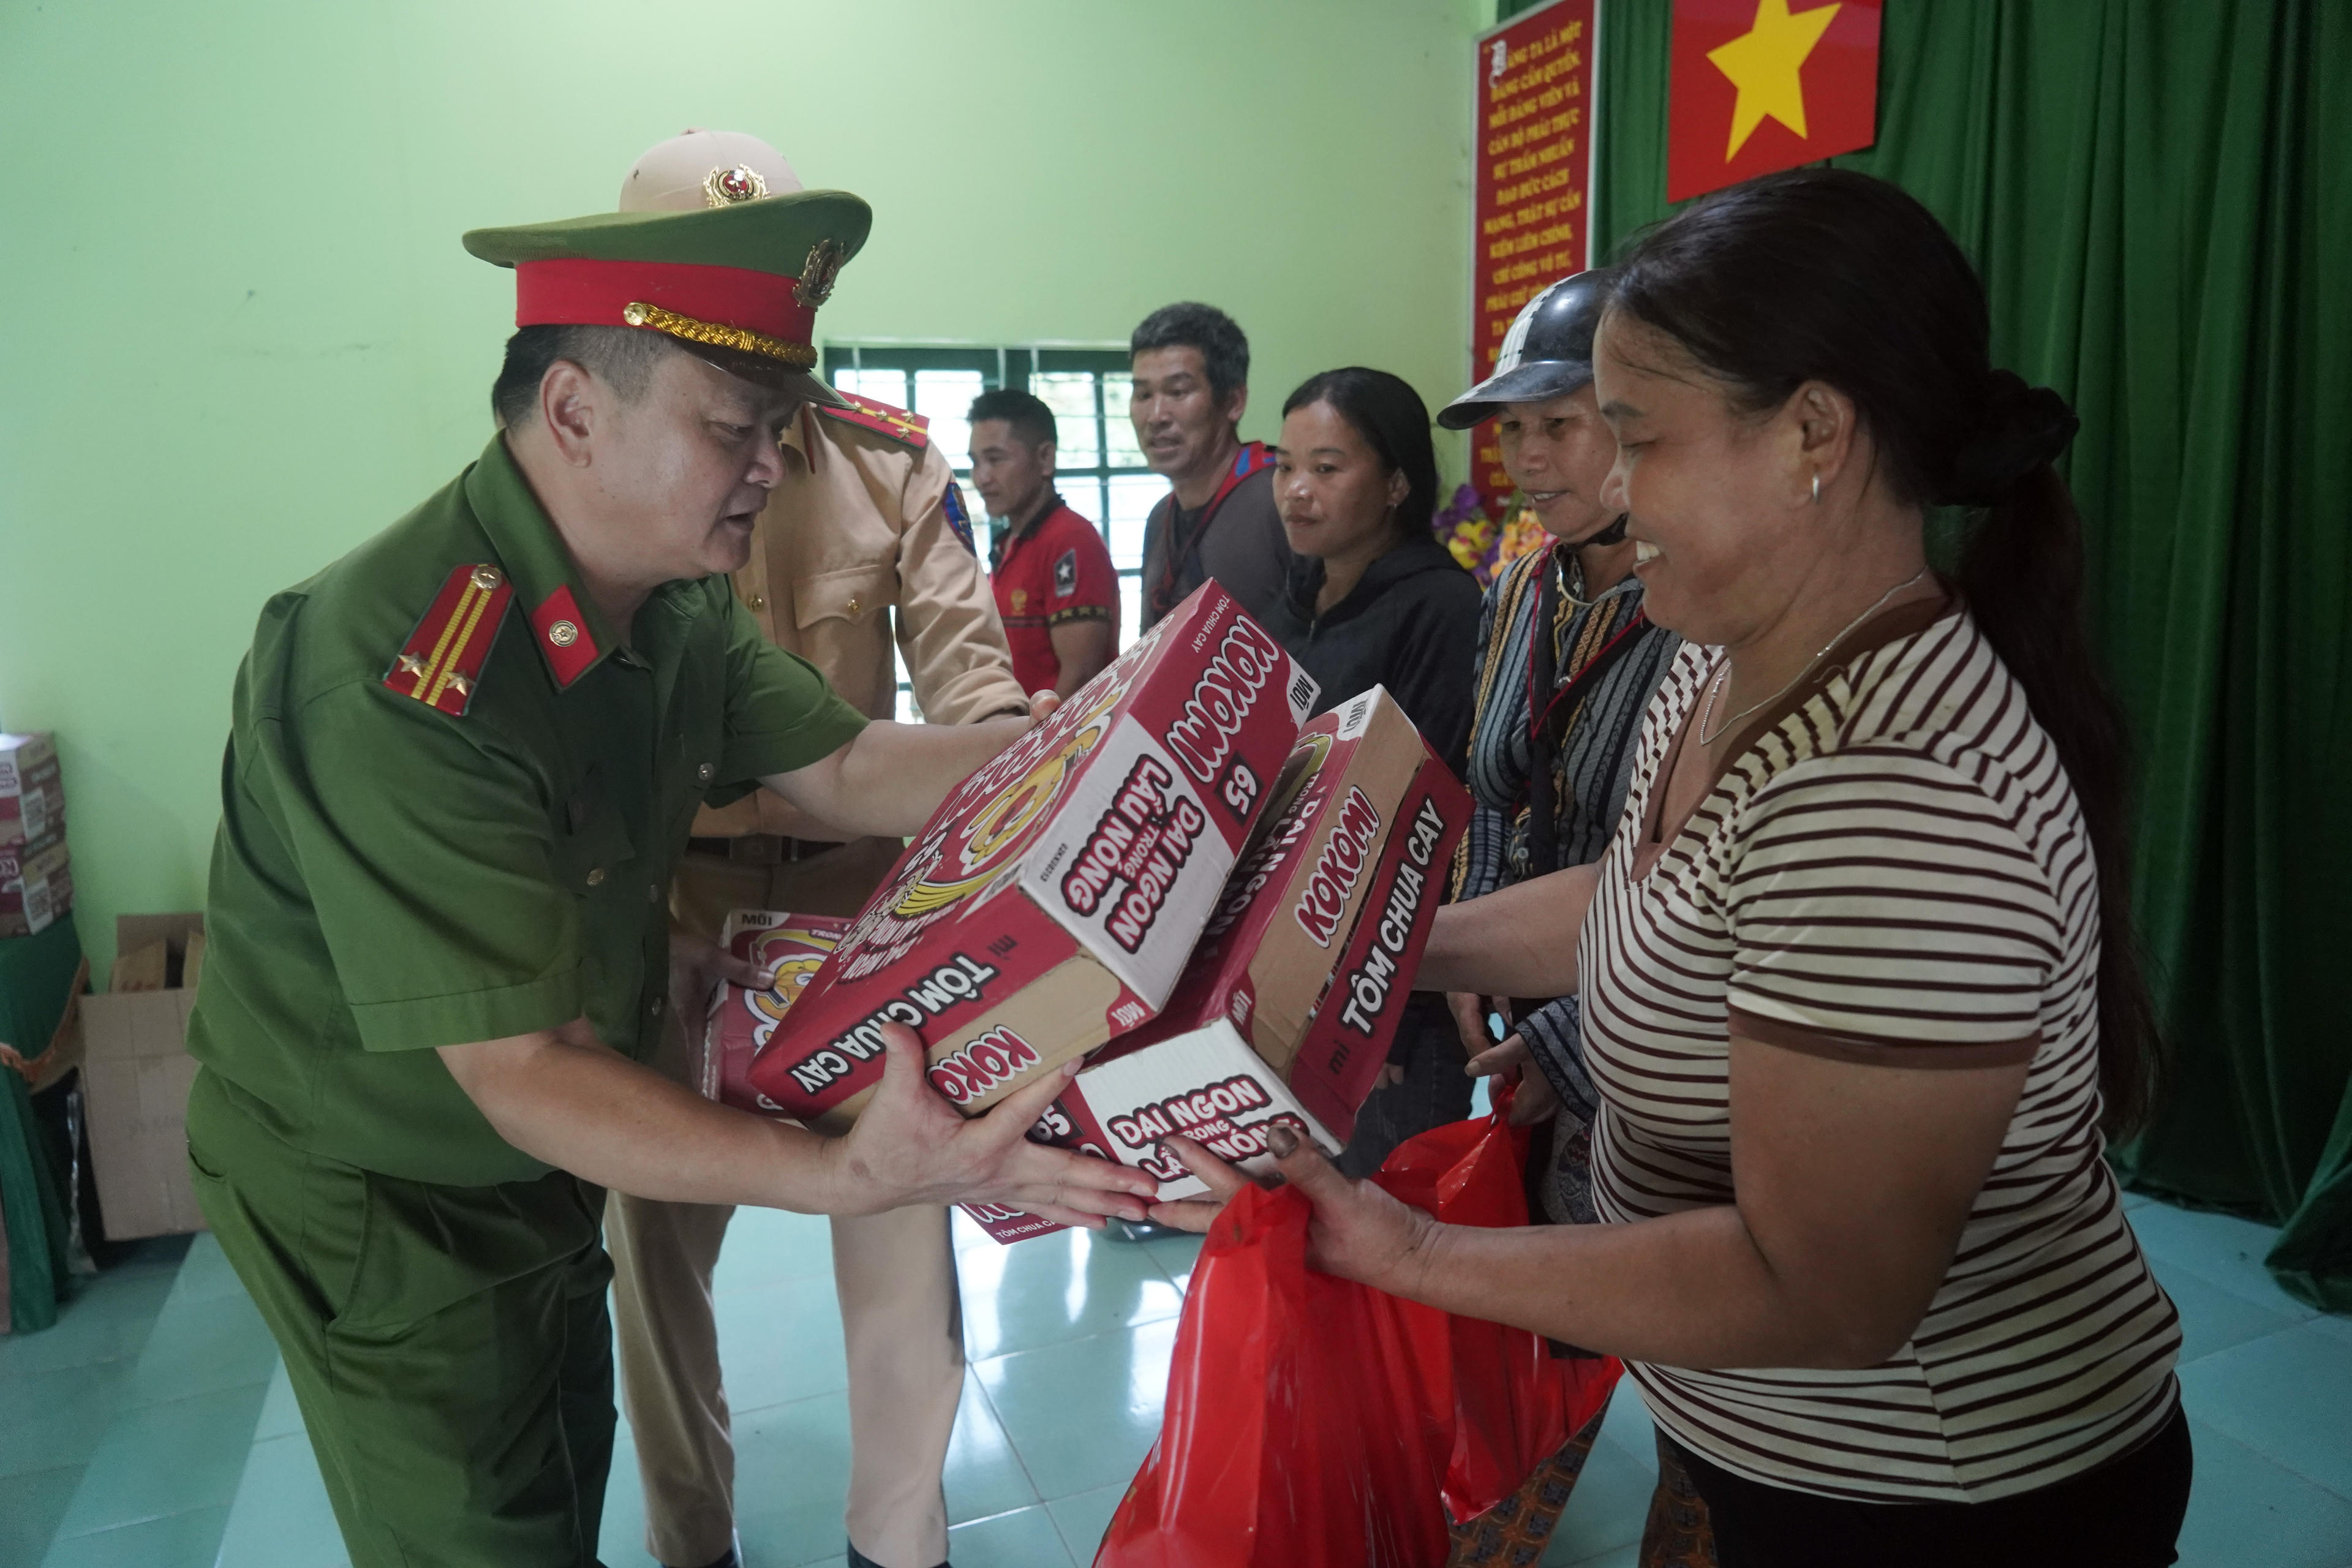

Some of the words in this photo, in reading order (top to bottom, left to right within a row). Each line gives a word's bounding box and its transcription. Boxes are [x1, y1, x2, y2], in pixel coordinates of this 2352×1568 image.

[1203, 611, 1221, 637] CHUA
[1213, 594, 1231, 614] TÔM
[1191, 635, 1208, 654] CAY
[1166, 614, 1280, 783] KOKOMI
[1224, 764, 1257, 815] 65
[1124, 825, 1160, 878] TRONG
[1161, 801, 1201, 862] DAI
[1068, 815, 1134, 911] NÓNG
[1294, 785, 1381, 949] KOKOMI
[1112, 854, 1174, 948] NGON
[1341, 945, 1396, 1035] TÔM
[1380, 862, 1424, 953] CHUA
[1408, 797, 1445, 866] CAY
[908, 955, 995, 1014] TÔM
[790, 1050, 850, 1093] CAY
[1114, 1109, 1170, 1145] DAI
[1167, 1079, 1263, 1125] NGON
[1185, 1120, 1230, 1141] RONG
[996, 1228, 1019, 1238] TÔM
[1017, 1223, 1044, 1233] CHUA
